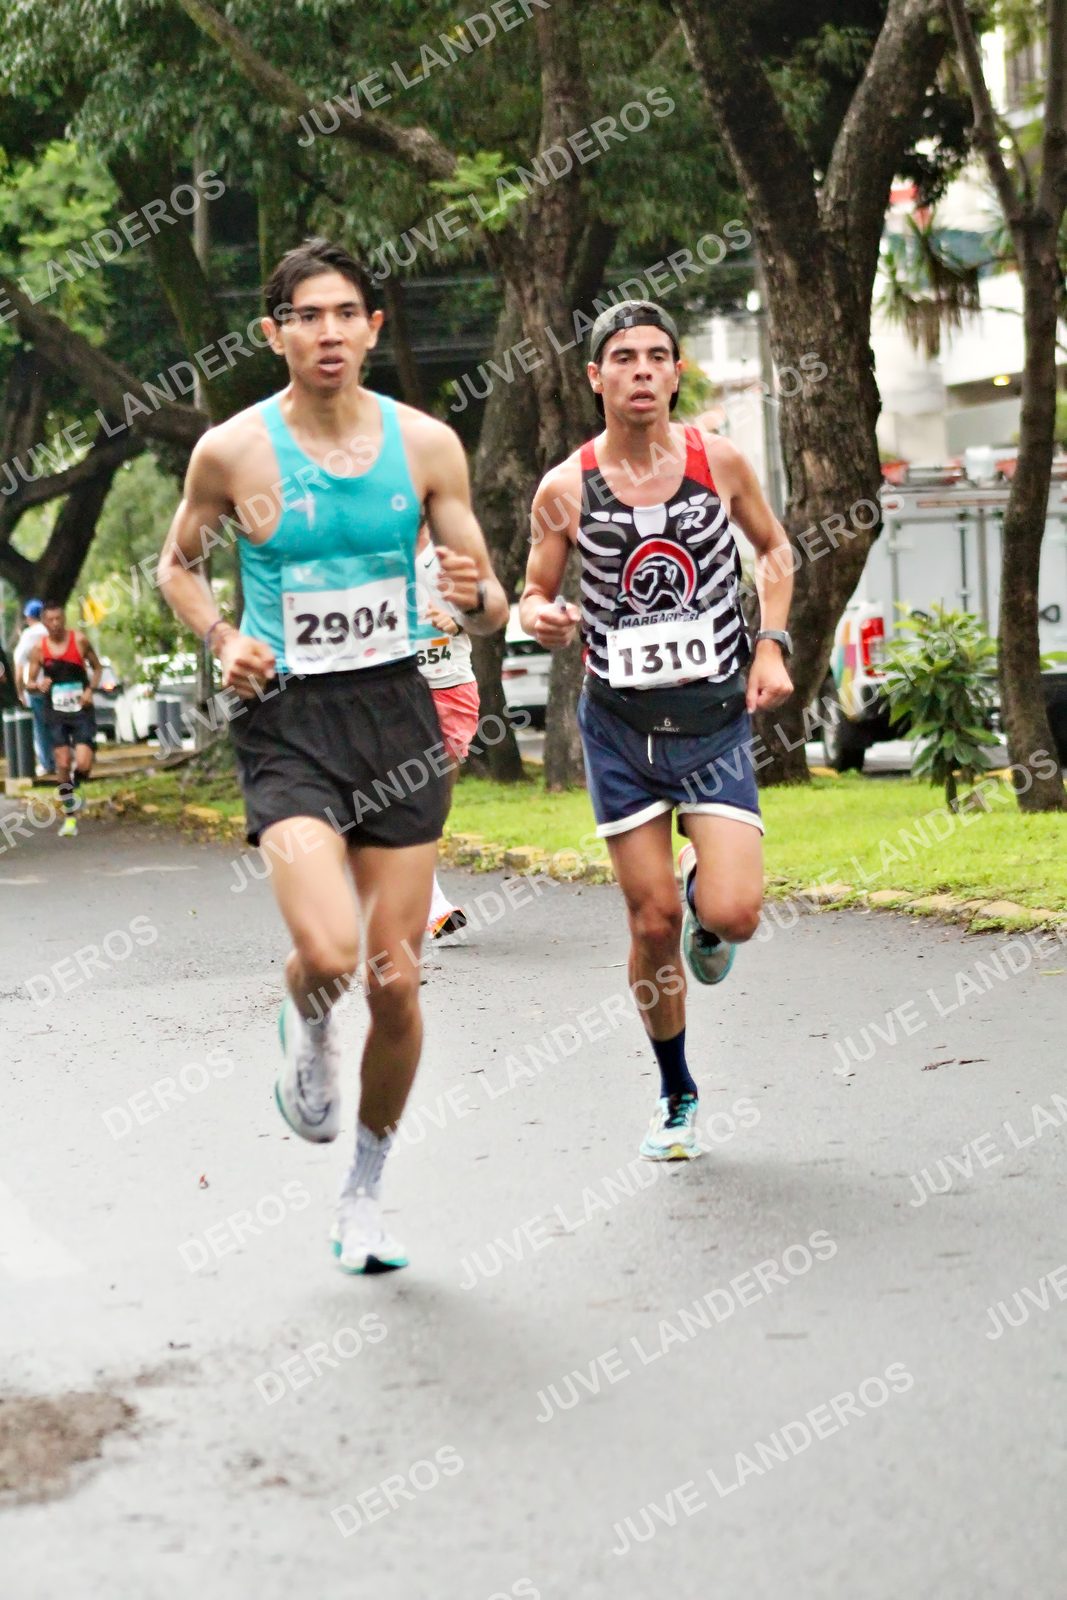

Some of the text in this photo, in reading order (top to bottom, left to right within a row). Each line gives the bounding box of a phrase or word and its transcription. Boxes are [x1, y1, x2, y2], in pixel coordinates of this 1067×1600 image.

[294, 600, 398, 645] 2904
[416, 646, 452, 667] 654
[618, 639, 707, 676] 1310
